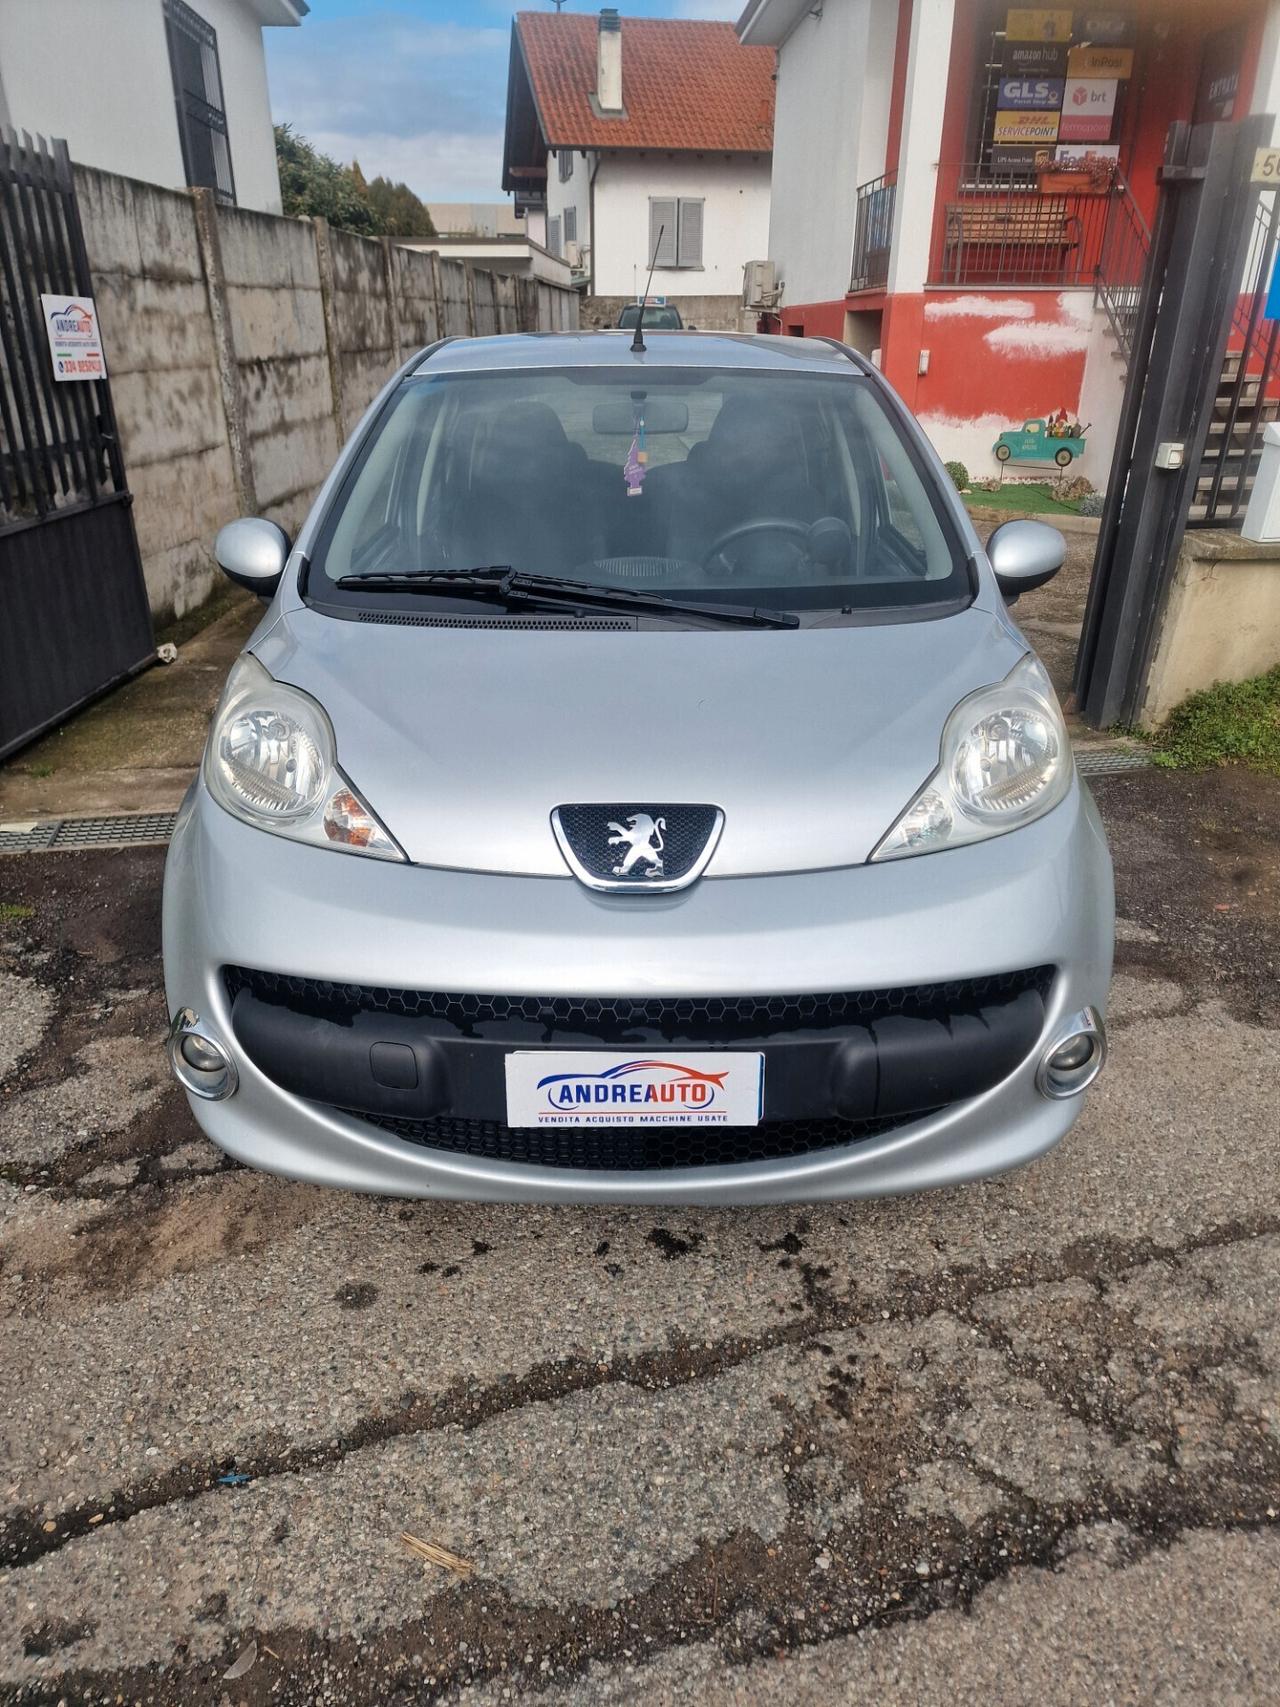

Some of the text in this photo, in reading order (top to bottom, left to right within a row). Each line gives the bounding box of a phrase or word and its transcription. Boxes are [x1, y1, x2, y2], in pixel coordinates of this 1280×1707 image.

[1012, 47, 1058, 61] amazon hub
[1004, 82, 1049, 97] GLS
[1091, 90, 1106, 102] brt
[1018, 116, 1050, 124] DHL
[997, 127, 1054, 136] SERVICEPOINT
[559, 1083, 706, 1103] ANDREAUTO
